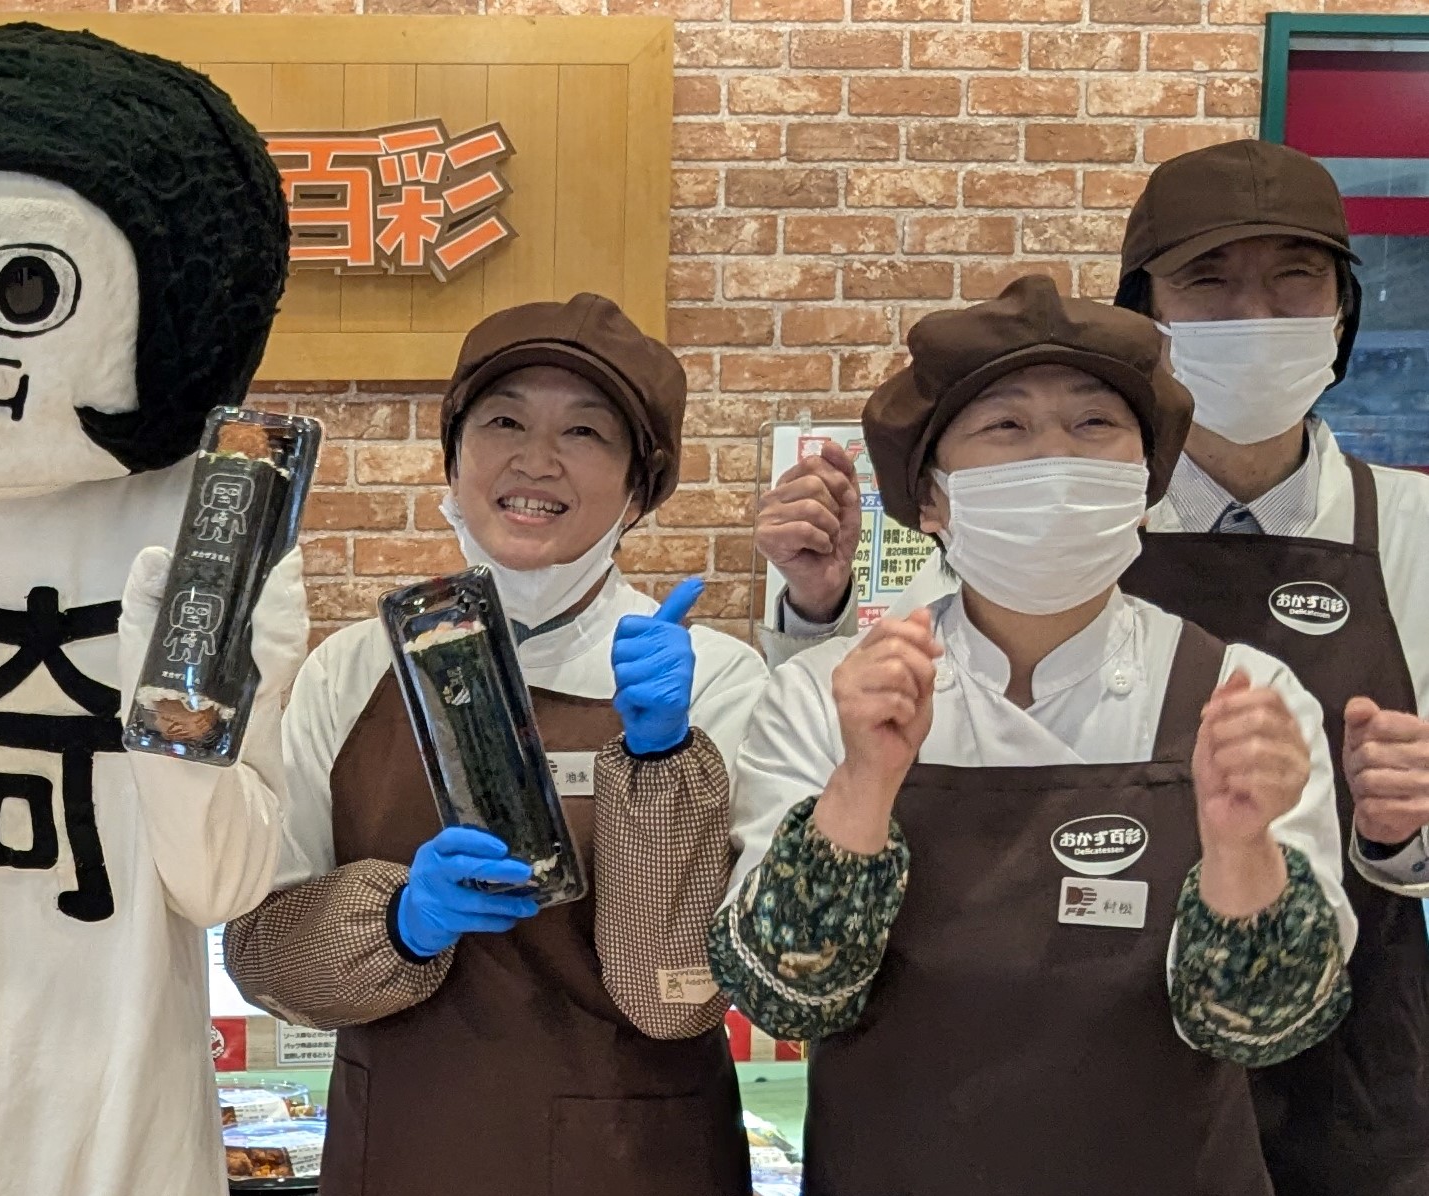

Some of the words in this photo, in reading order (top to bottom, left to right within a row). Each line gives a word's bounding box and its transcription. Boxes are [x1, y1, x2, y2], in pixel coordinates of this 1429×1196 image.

[268, 126, 508, 271] 百彩
[1275, 593, 1344, 613] おかず百彩
[1059, 828, 1141, 847] おかず百彩
